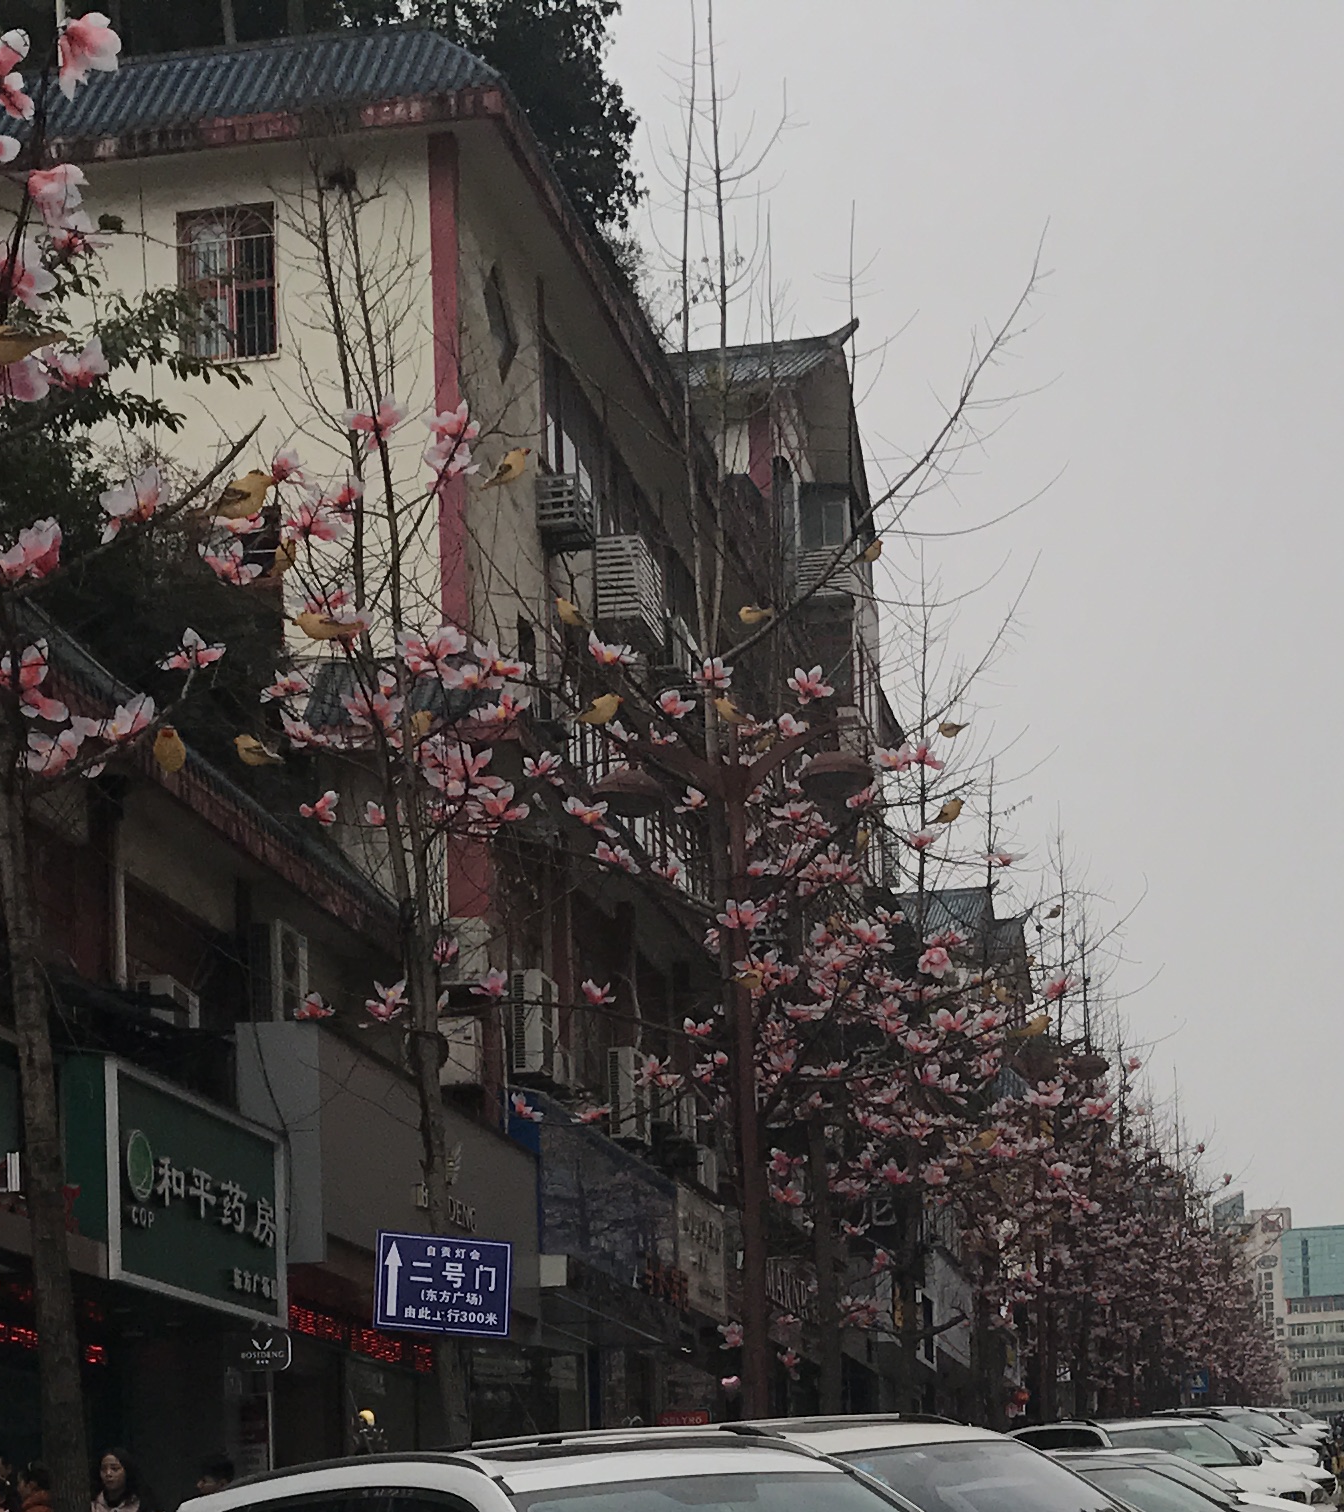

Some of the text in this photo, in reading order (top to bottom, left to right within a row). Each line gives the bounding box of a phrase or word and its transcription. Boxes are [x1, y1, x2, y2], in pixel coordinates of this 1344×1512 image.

[156, 1157, 276, 1248] 和平药房
[426, 1245, 481, 1261] 自贡灯会
[409, 1261, 497, 1292] 二号门
